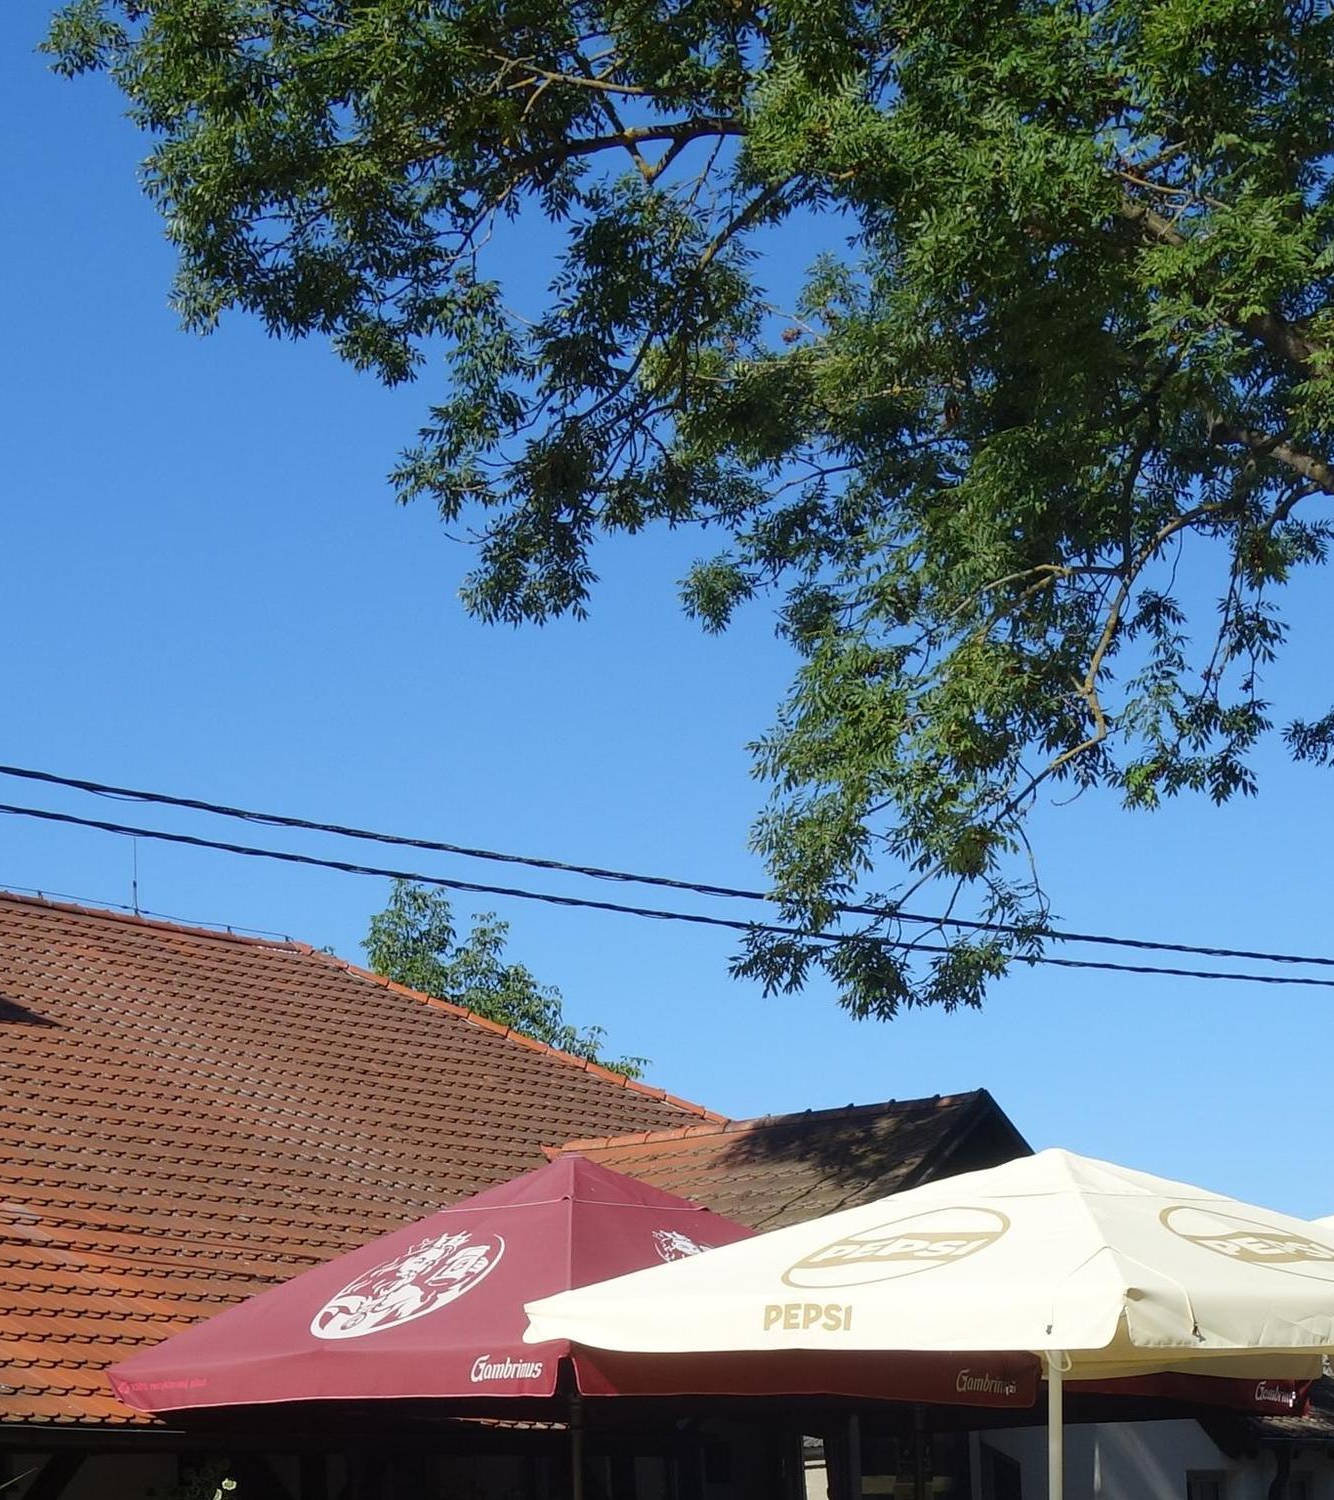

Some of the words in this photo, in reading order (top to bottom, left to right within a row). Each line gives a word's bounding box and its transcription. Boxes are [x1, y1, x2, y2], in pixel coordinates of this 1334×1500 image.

[809, 1236, 987, 1262] PEPSI
[763, 1303, 853, 1331] PEPSI
[470, 1354, 544, 1383] Gambrinus
